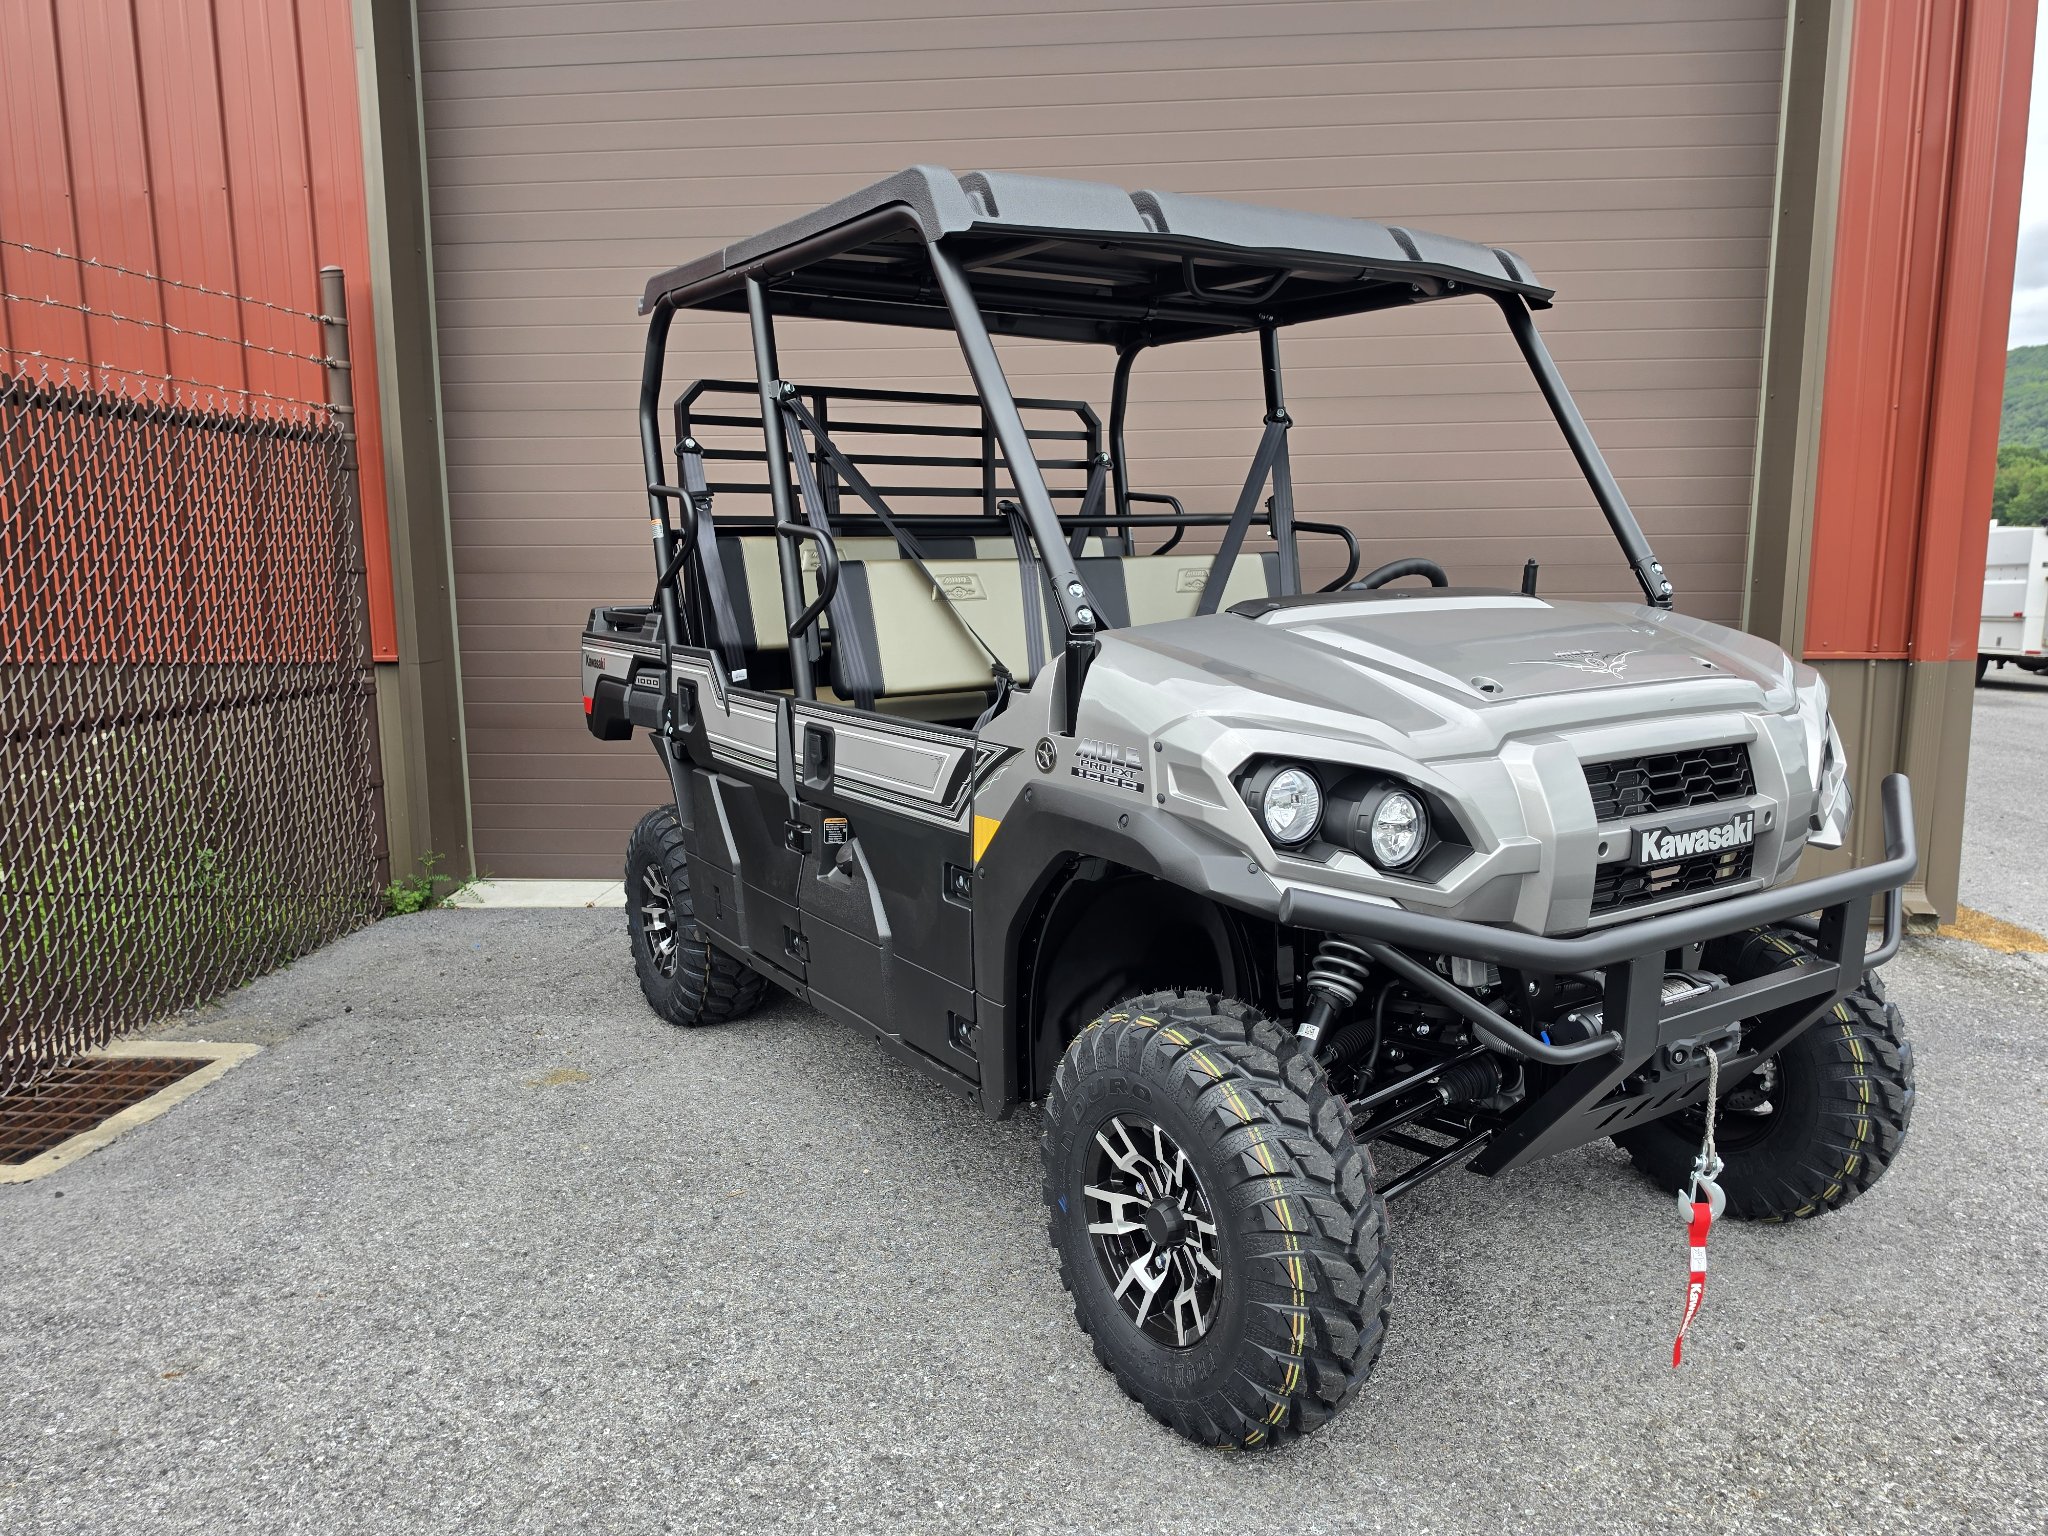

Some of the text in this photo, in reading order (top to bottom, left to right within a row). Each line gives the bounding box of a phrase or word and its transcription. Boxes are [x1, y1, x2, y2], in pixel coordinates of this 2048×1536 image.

[585, 654, 606, 670] Kawasaki
[637, 677, 659, 686] 1000
[1075, 737, 1143, 771] MULE
[1076, 768, 1140, 792] 1000
[1641, 814, 1754, 863] Kawasaki
[1072, 1076, 1153, 1125] DURO
